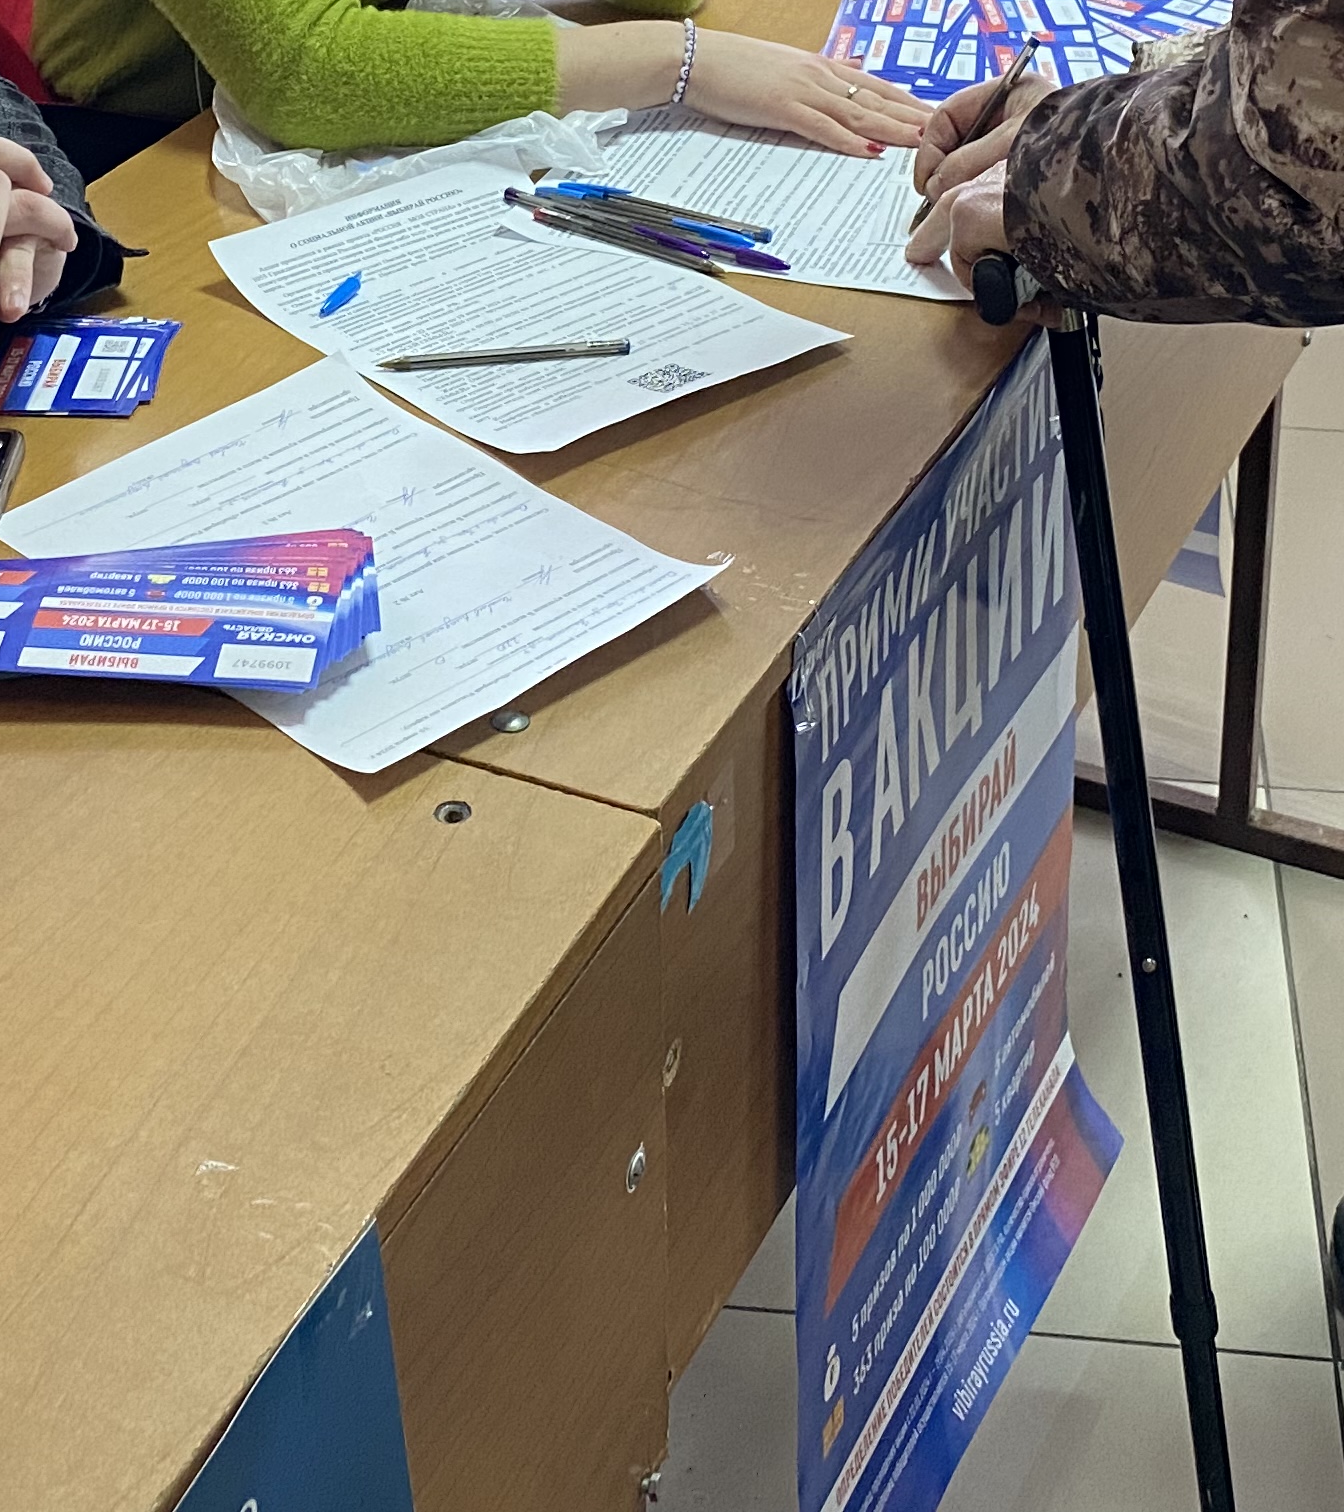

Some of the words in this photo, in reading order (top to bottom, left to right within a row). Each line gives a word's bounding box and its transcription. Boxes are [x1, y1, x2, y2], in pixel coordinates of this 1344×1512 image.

[211, 577, 230, 586] 100
[280, 581, 299, 590] 363
[57, 585, 128, 596] автомобилей
[62, 614, 96, 627] 2024
[97, 616, 141, 630] МАРТА
[141, 619, 181, 631] 15-17
[222, 624, 274, 633] ОБЛАСТЬ
[79, 634, 142, 649] РОССИЮ
[236, 631, 316, 644] ОМСКАЯ
[817, 519, 939, 764] ПРИМИ
[68, 654, 138, 669] ВЫБИРАЙ
[231, 657, 293, 671] 1099747
[821, 757, 855, 962] В
[868, 448, 1066, 880] АКЦИИ
[914, 727, 1017, 933] ВЫБИРАЙ
[921, 840, 1011, 1022] РОССИЮ
[875, 1064, 930, 1205] 15-17
[933, 958, 995, 1099] МАРТА
[997, 881, 1041, 991] 2024
[860, 1249, 897, 1330] призов
[897, 1223, 911, 1257] по
[918, 1169, 938, 1219] 000
[853, 1342, 873, 1396] 363
[874, 1289, 904, 1358] приза
[904, 1263, 917, 1298] по
[918, 1223, 936, 1272] 100
[951, 1297, 1021, 1422] vibirayrussia.ru
[835, 1397, 888, 1506] ОПРЕДЕЛЕНИЕ
[885, 1315, 935, 1412] ПОБЕДИТЕЛЕЙ
[933, 1245, 969, 1321] СОСТОИТСЯ
